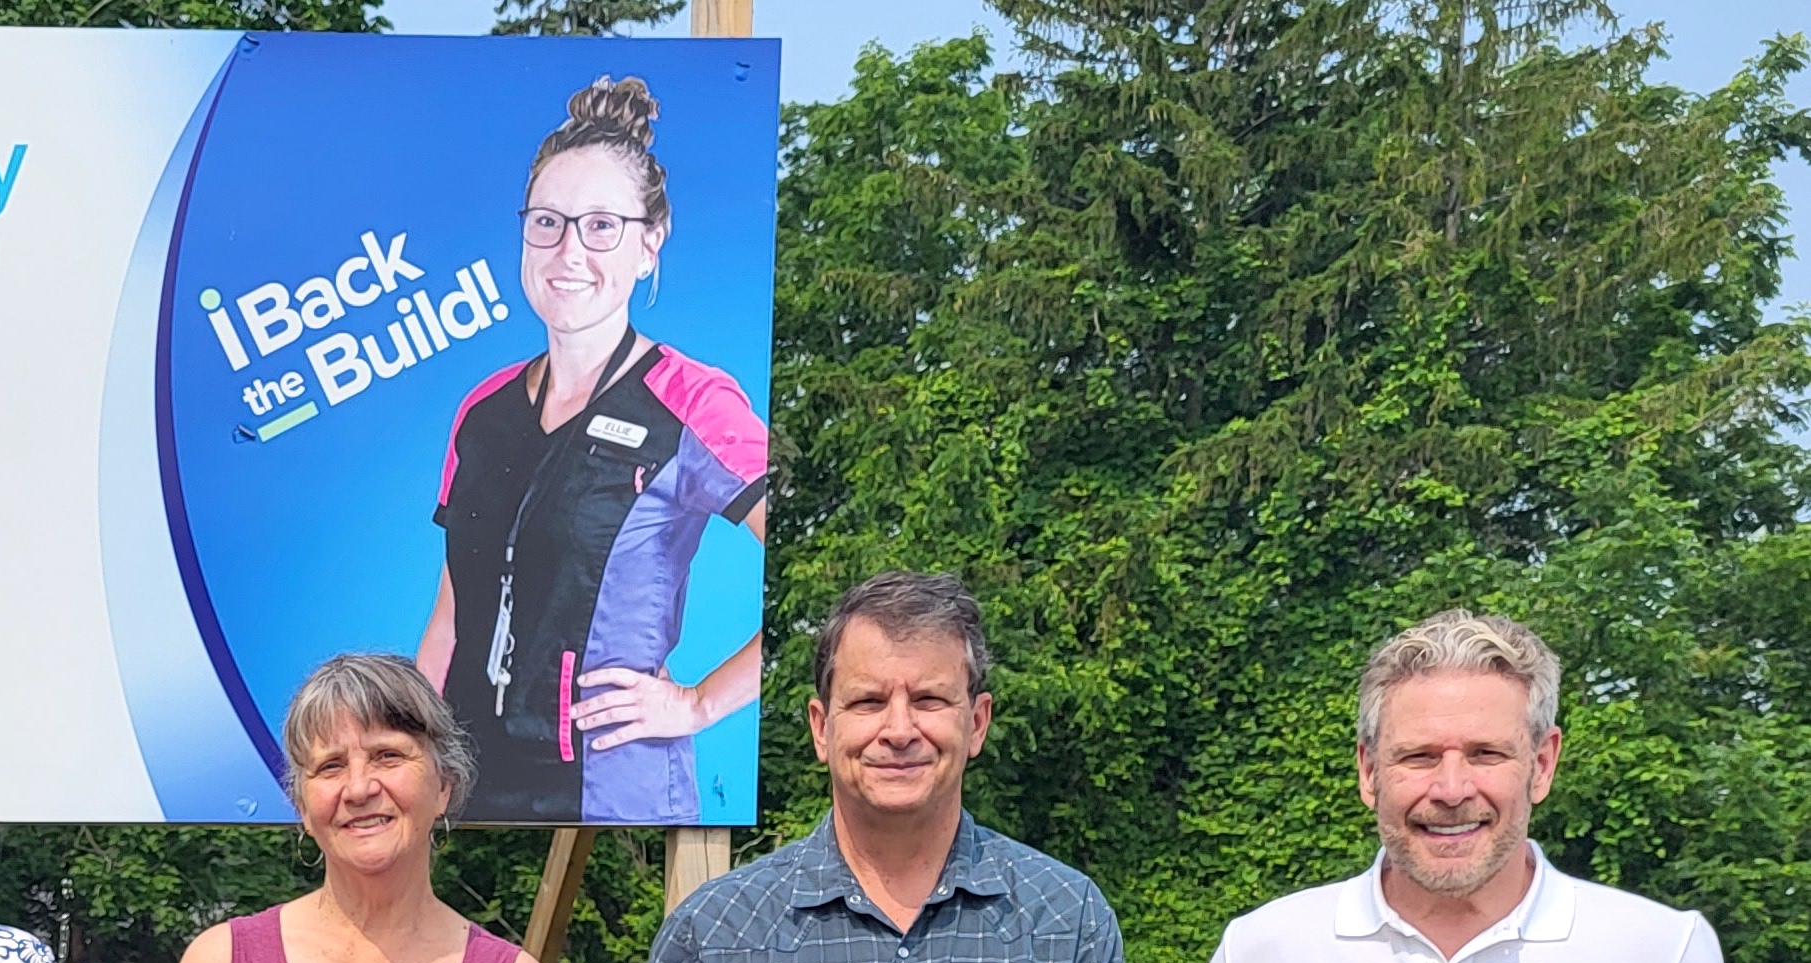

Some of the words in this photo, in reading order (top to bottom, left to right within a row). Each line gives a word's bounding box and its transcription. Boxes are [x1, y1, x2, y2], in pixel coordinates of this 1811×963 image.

[235, 231, 426, 357] Back
[241, 368, 306, 417] the
[304, 258, 510, 407] Build!
